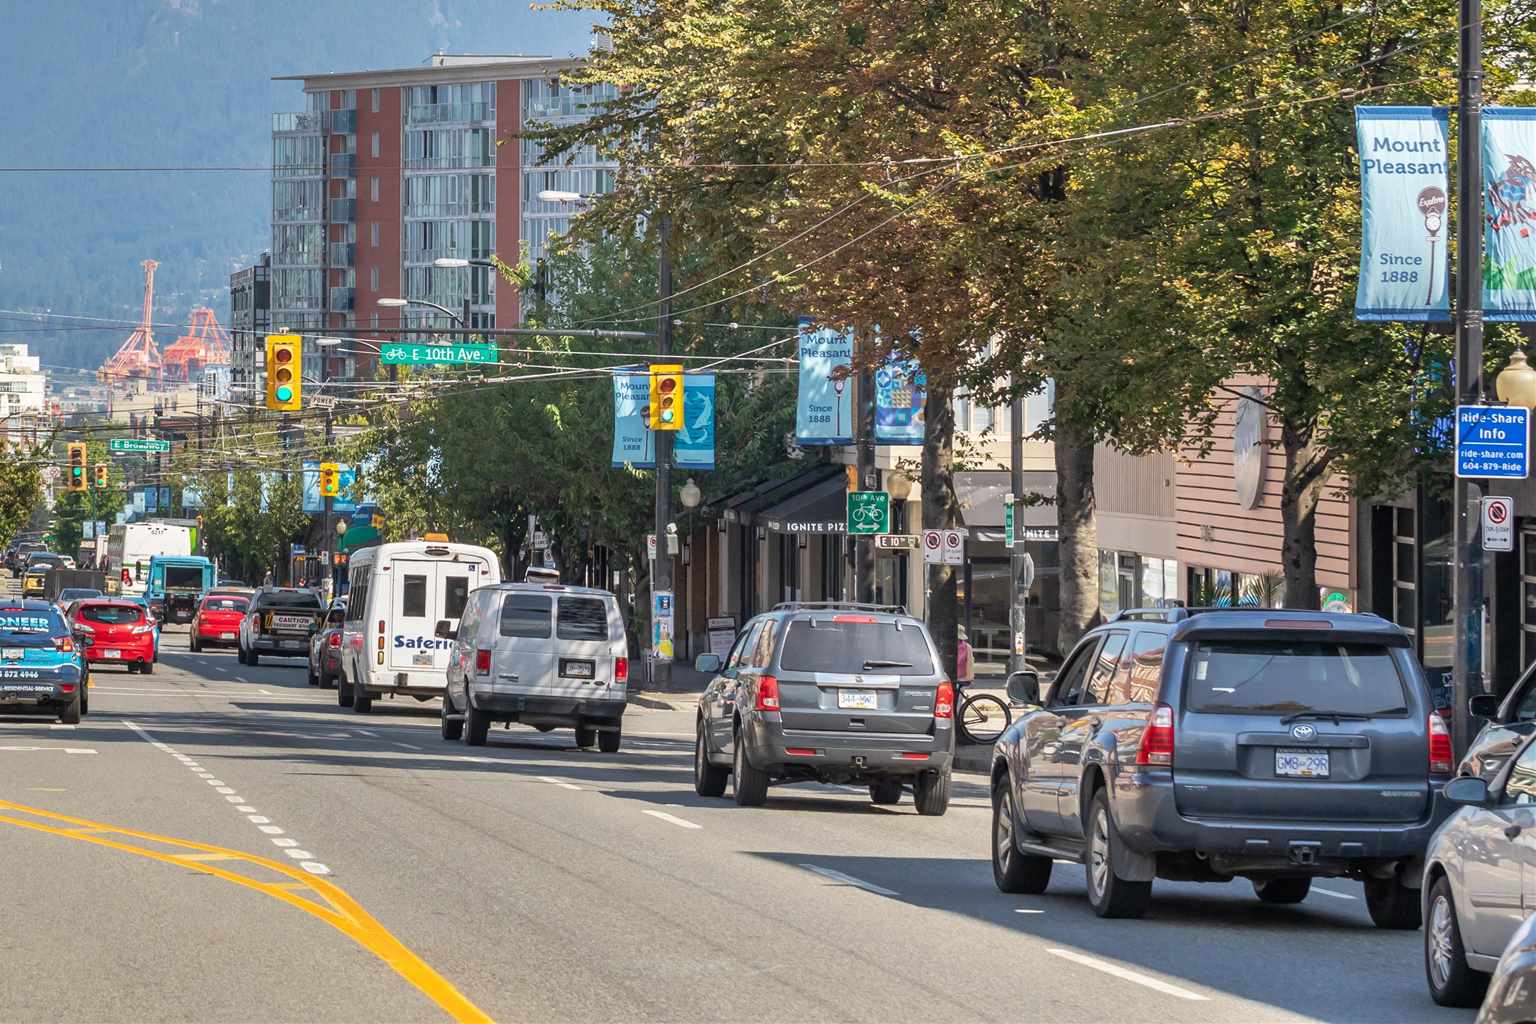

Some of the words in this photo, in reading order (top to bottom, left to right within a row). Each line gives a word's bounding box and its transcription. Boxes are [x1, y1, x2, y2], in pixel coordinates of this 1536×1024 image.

[1373, 137, 1441, 153] Mount
[1379, 253, 1423, 266] Since
[1380, 271, 1419, 284] 1888
[806, 335, 848, 344] Mount
[412, 349, 419, 361] E
[425, 348, 454, 361] 10th
[457, 348, 485, 361] Ave.
[800, 348, 851, 358] Pleasant
[620, 382, 651, 390] Moun
[808, 404, 833, 413] Since
[1461, 413, 1525, 424] Ride-Share
[1479, 428, 1506, 440] Info
[115, 441, 121, 449] E
[1461, 449, 1524, 459] ride-share.com
[1462, 462, 1522, 471] 604-879-Ride
[786, 522, 824, 532] IGNITE
[827, 522, 848, 532] PIZ
[881, 537, 887, 546] E
